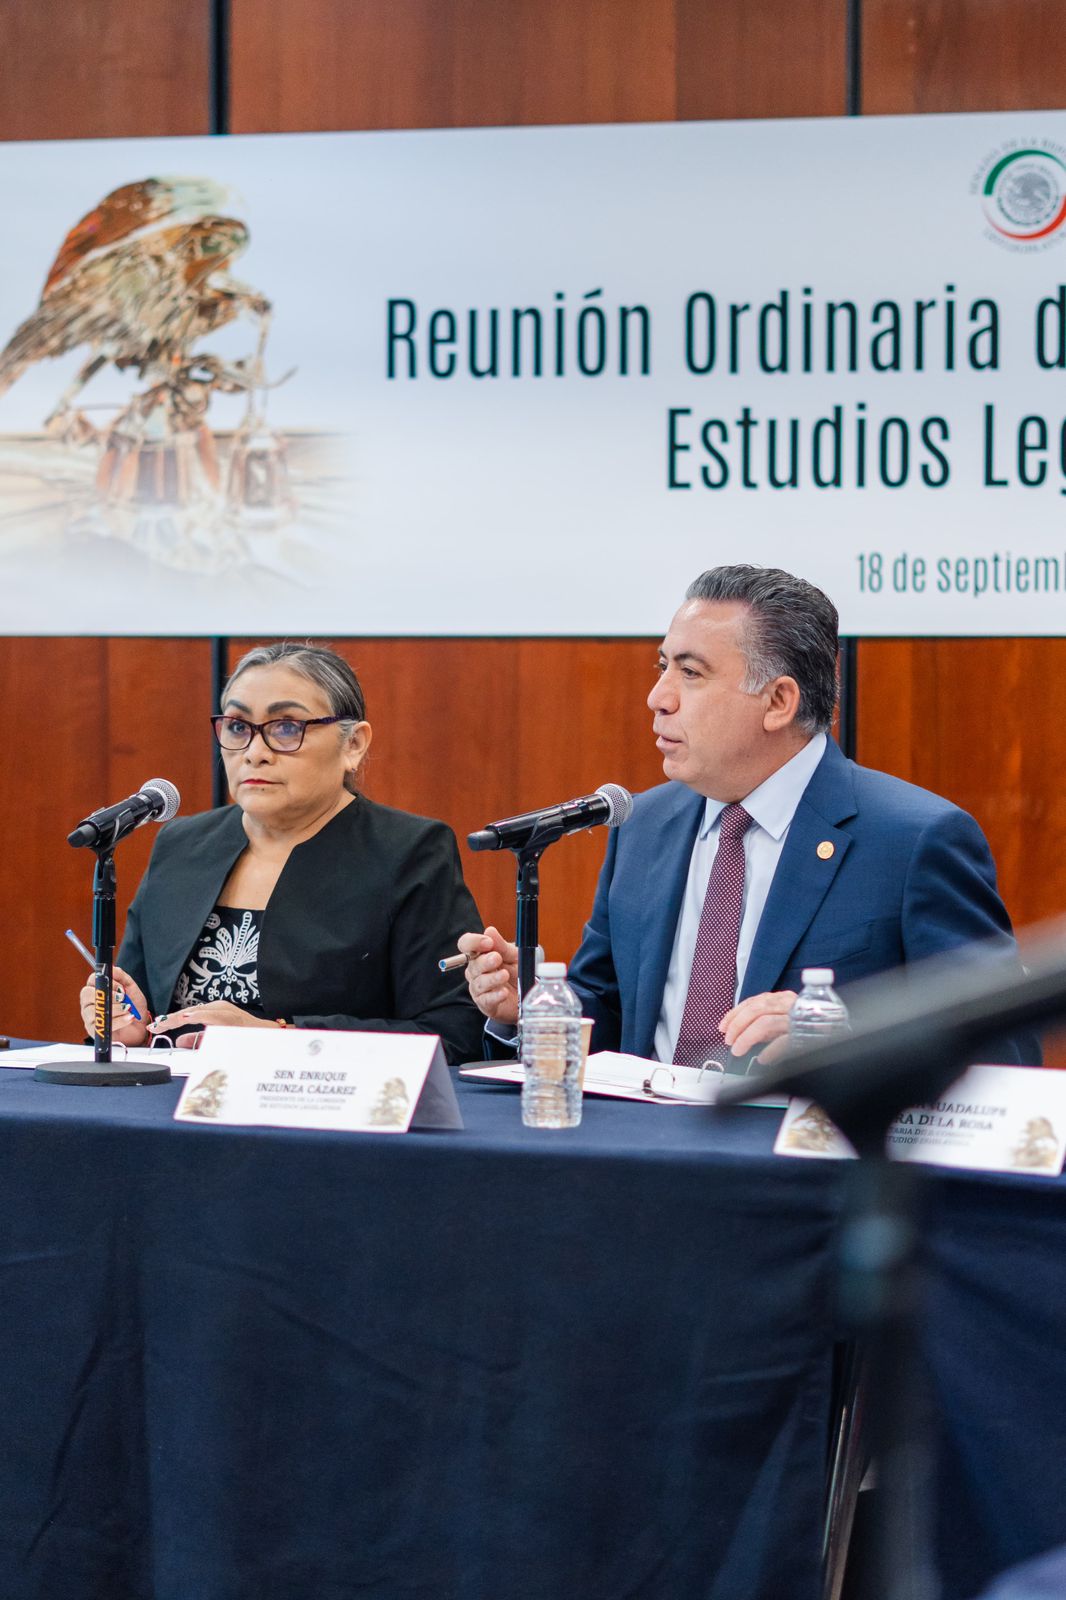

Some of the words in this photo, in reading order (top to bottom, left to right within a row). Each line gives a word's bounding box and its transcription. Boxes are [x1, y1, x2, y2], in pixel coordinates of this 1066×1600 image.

[387, 288, 650, 379] Reunión
[685, 285, 1000, 375] Ordinaria
[668, 403, 950, 490] Estudios
[985, 403, 1066, 496] Le
[857, 552, 883, 592] 18
[893, 552, 926, 592] de
[937, 552, 1066, 598] septiem
[95, 990, 105, 1037] auray
[256, 1083, 303, 1093] INZUNZA
[299, 1071, 347, 1082] ENRIQUE
